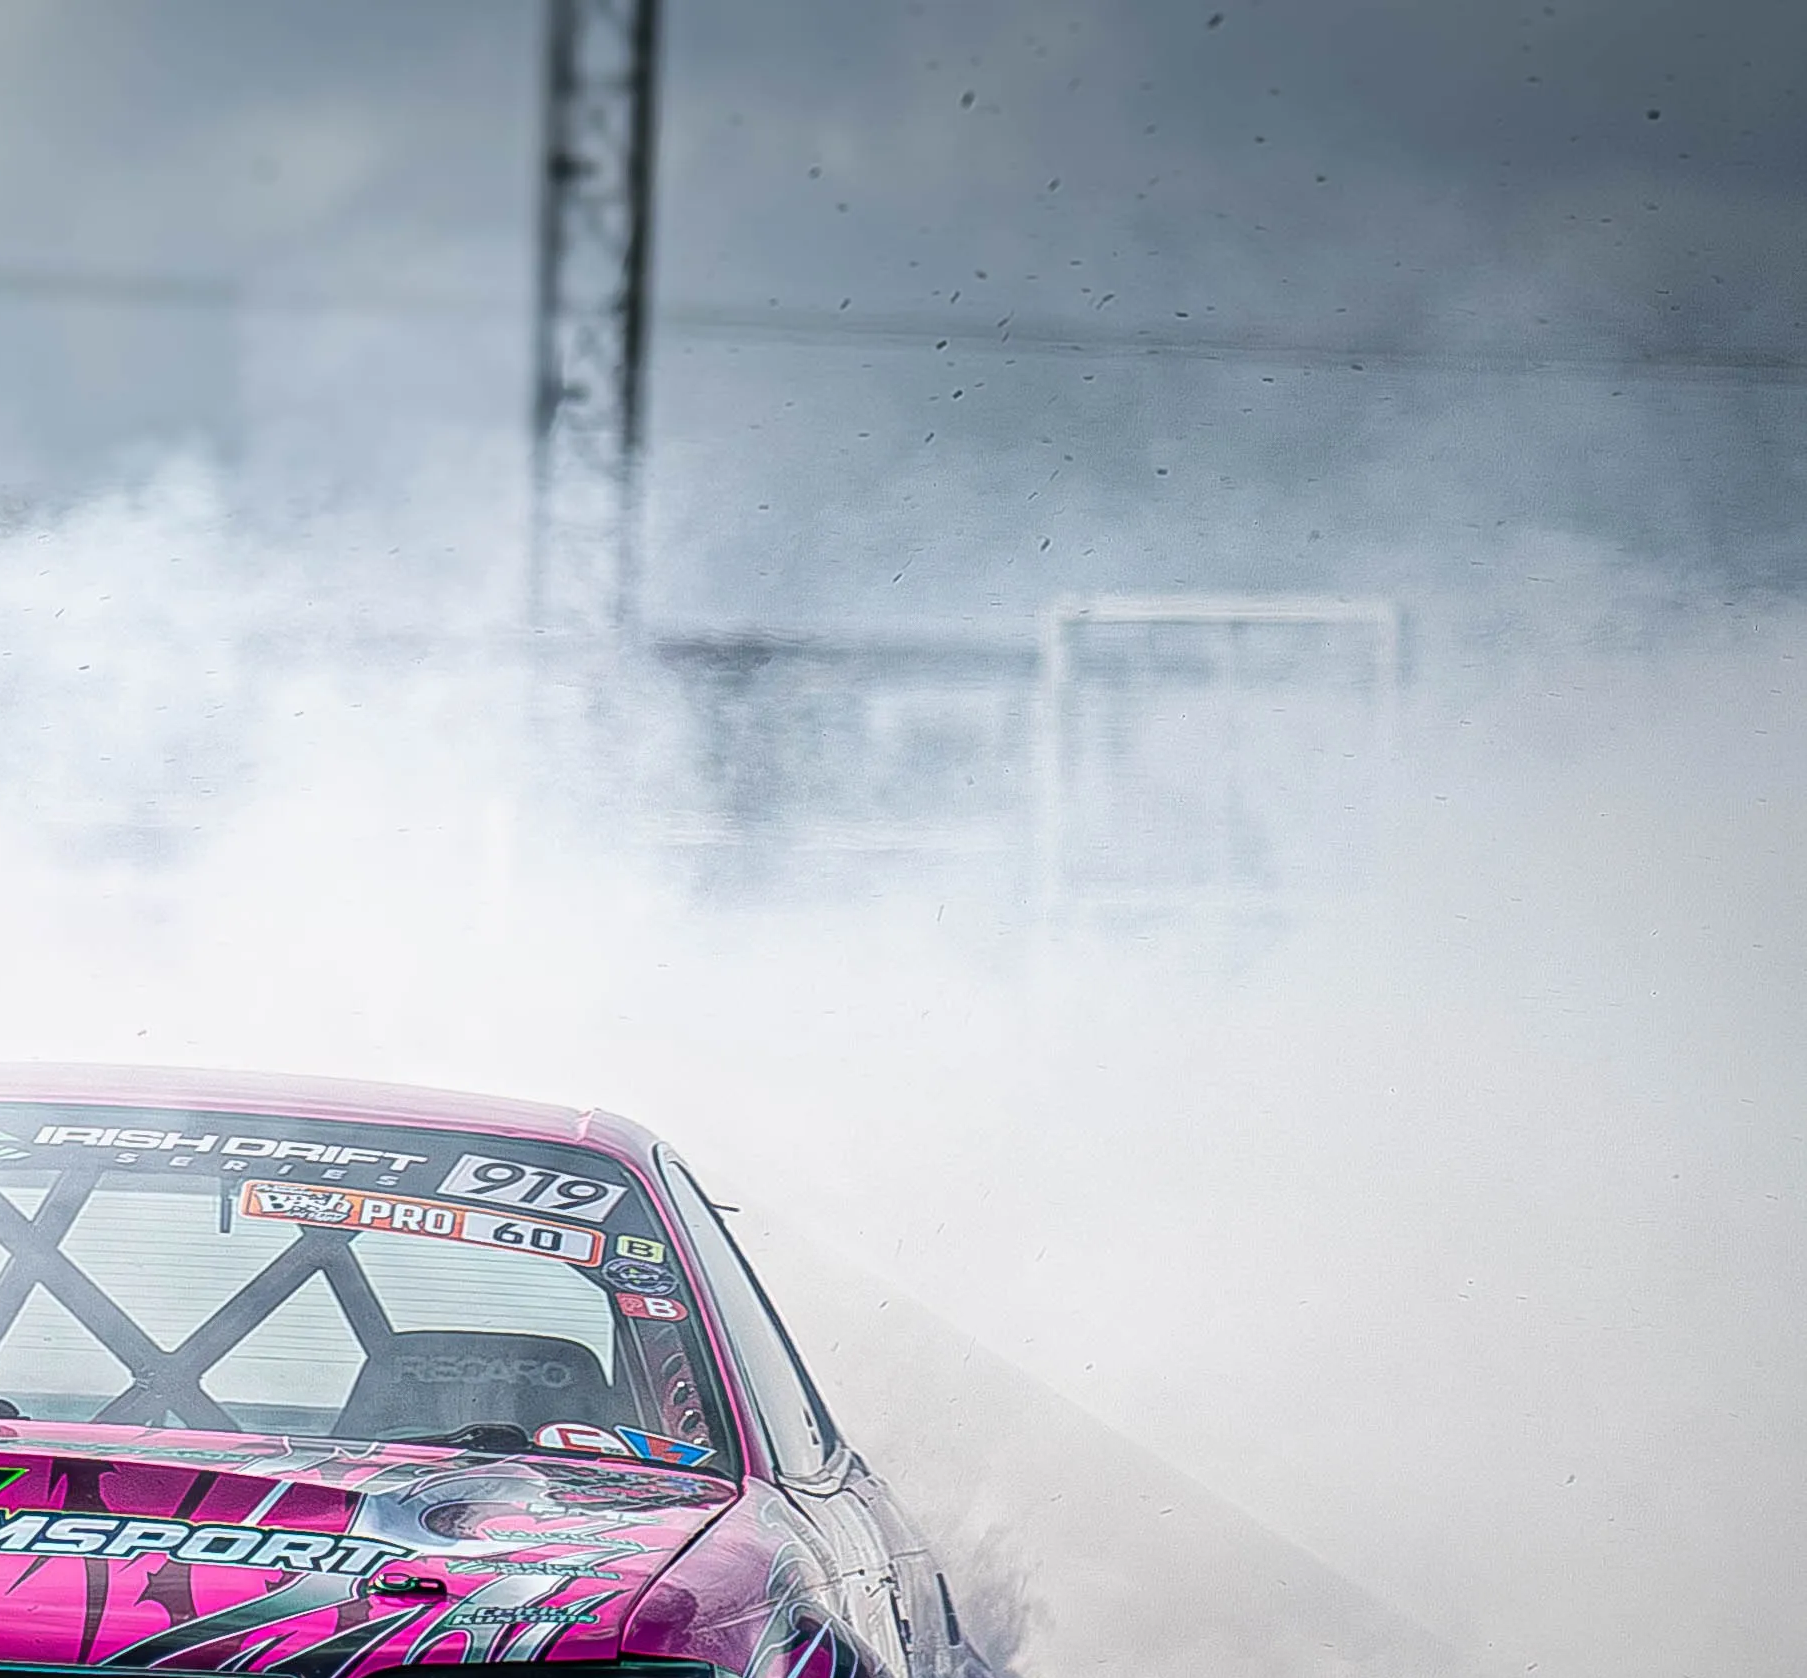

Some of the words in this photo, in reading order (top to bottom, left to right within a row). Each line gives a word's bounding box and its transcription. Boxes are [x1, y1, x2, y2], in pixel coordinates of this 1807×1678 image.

[33, 1126, 219, 1152] IRISH
[219, 1137, 428, 1172] DRIFT
[115, 1151, 400, 1188] SERIES
[469, 1161, 610, 1214] 919
[359, 1198, 455, 1236] PRO
[492, 1219, 563, 1253] 60
